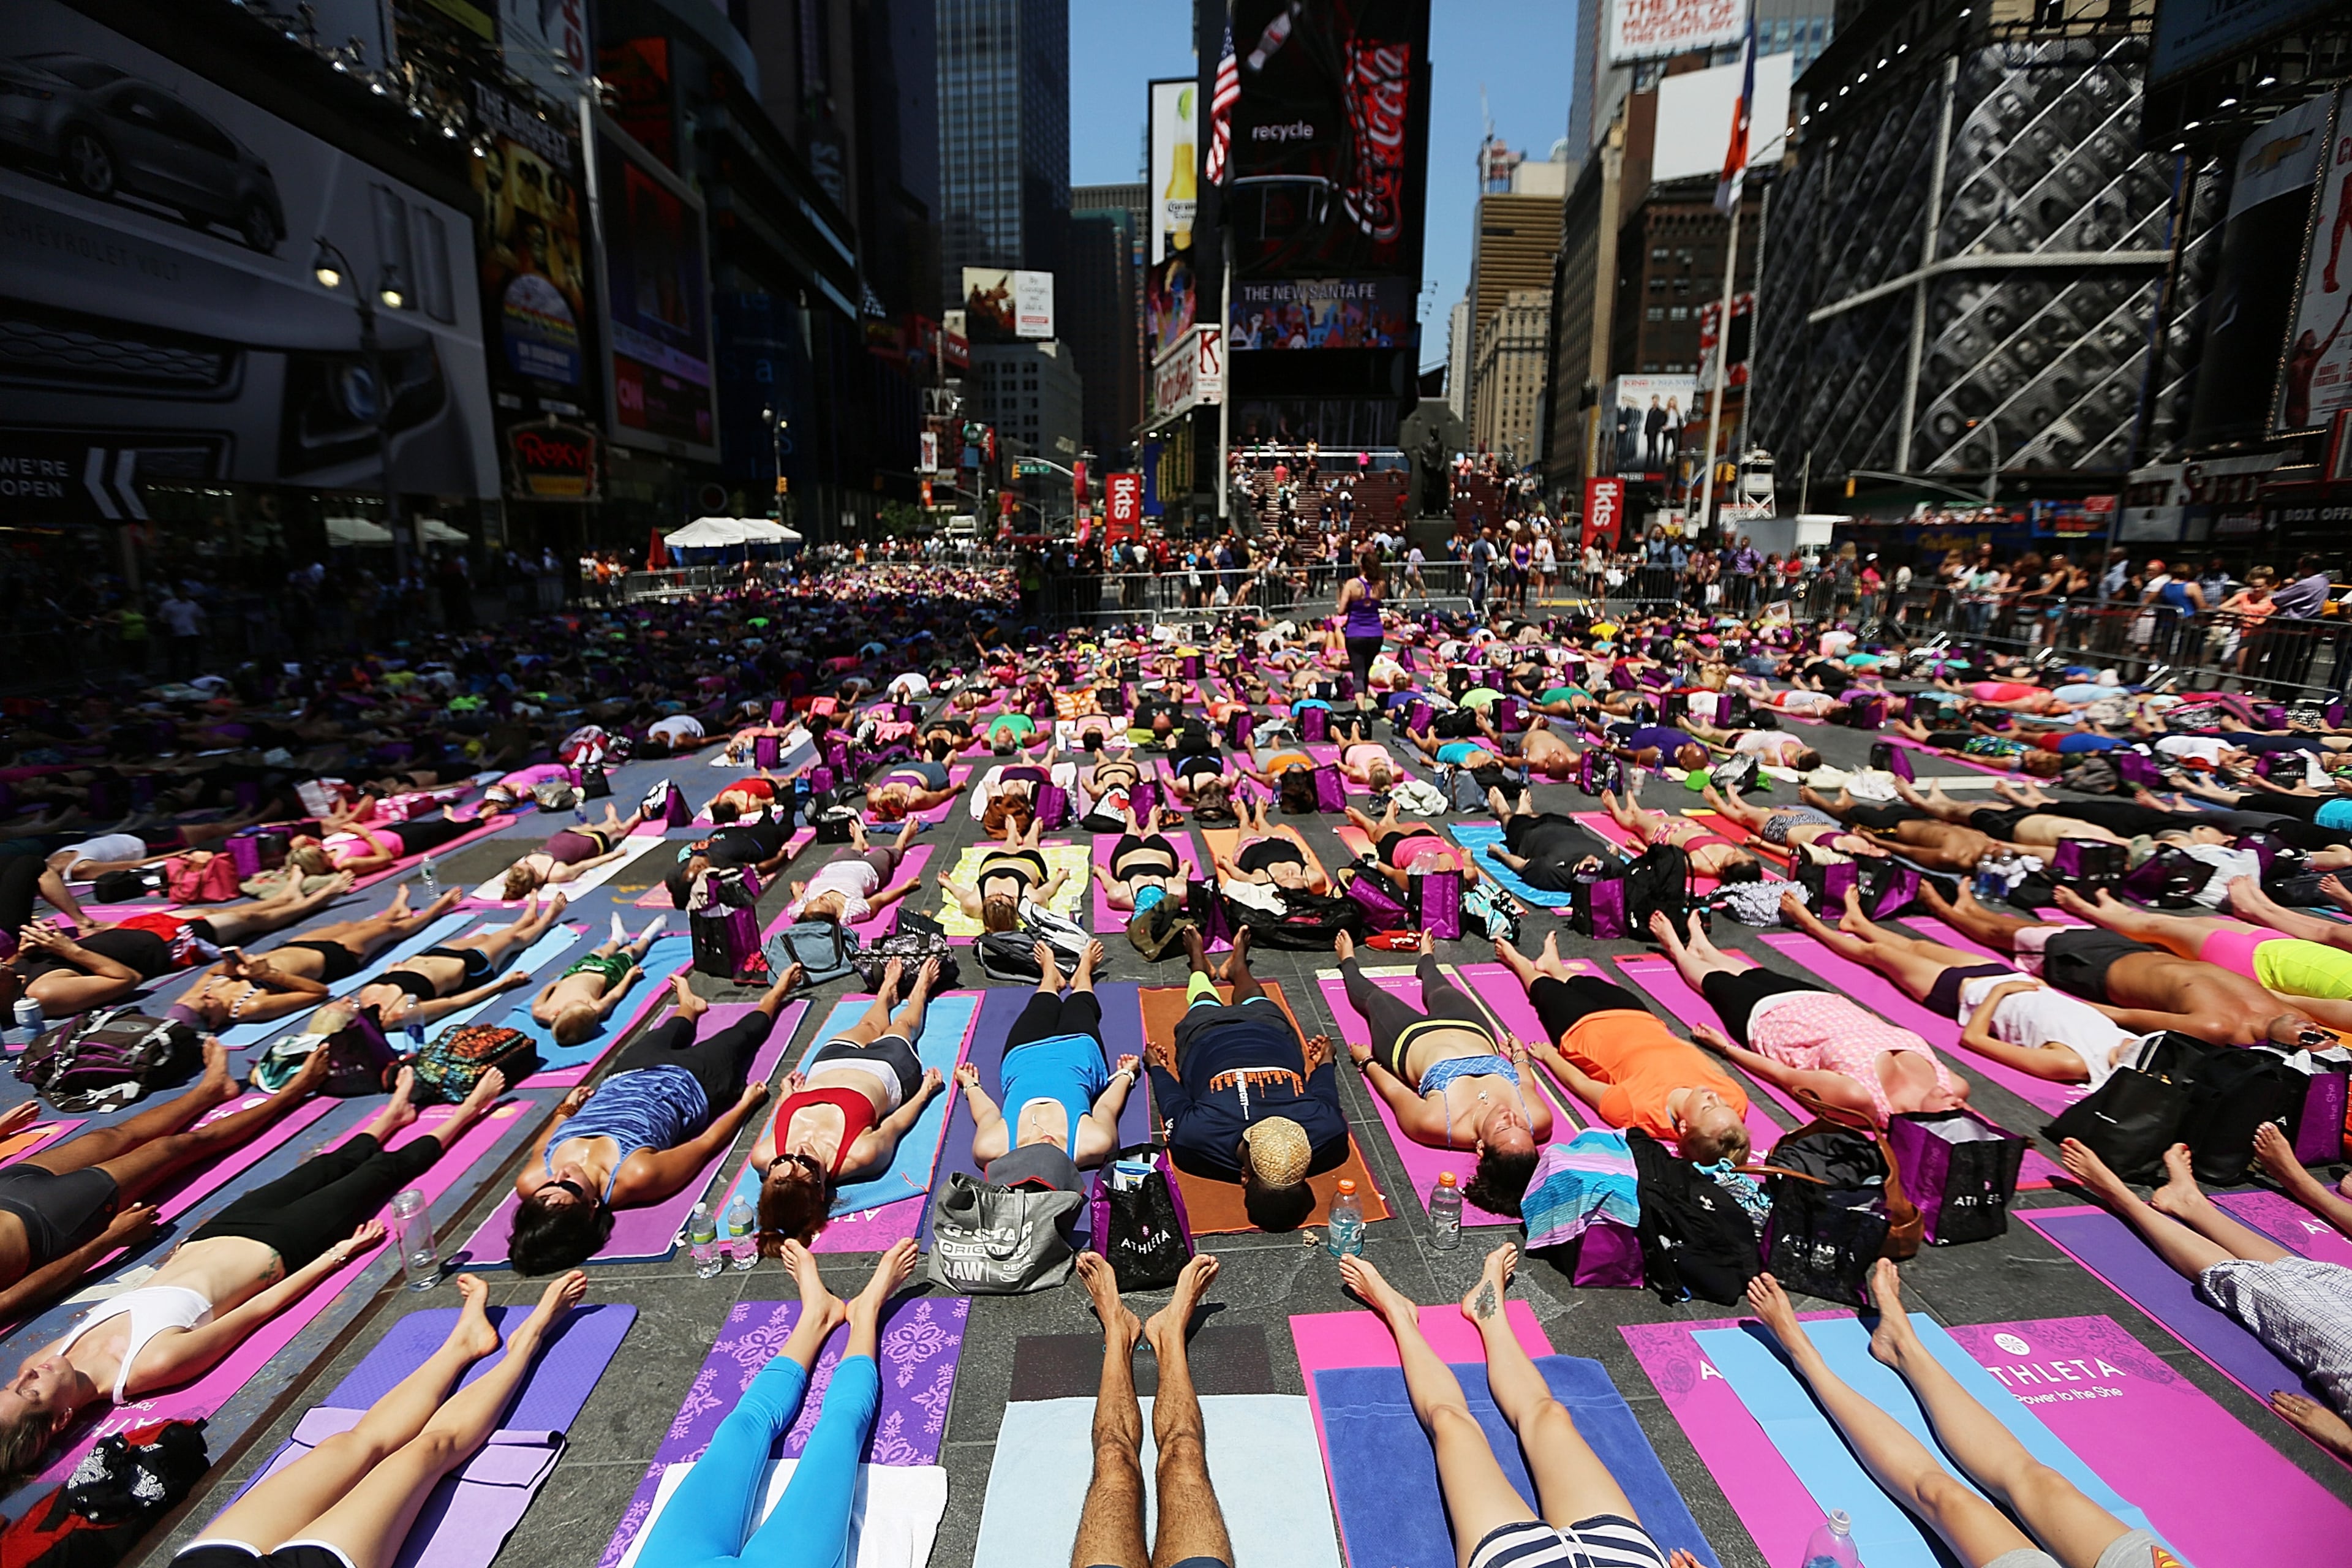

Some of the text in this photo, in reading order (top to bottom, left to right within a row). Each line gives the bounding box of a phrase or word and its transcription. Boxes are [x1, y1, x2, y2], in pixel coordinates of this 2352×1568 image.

[1251, 120, 1315, 144] recycle
[1244, 282, 1377, 301] THE NEW SANTA FE
[1623, 379, 1649, 388] KING
[0, 456, 69, 479] WE'RE
[0, 478, 64, 499] OPEN
[1114, 477, 1136, 520] tkts
[1593, 481, 1618, 527] tkts
[2283, 508, 2316, 522] BOX
[943, 1221, 1033, 1243] G-STAR
[1120, 1229, 1172, 1254] ATHLETA
[1985, 1357, 2127, 1387] THLETA
[2054, 1390, 2074, 1401] to
[2070, 1388, 2097, 1400] the
[2092, 1385, 2124, 1398] She
